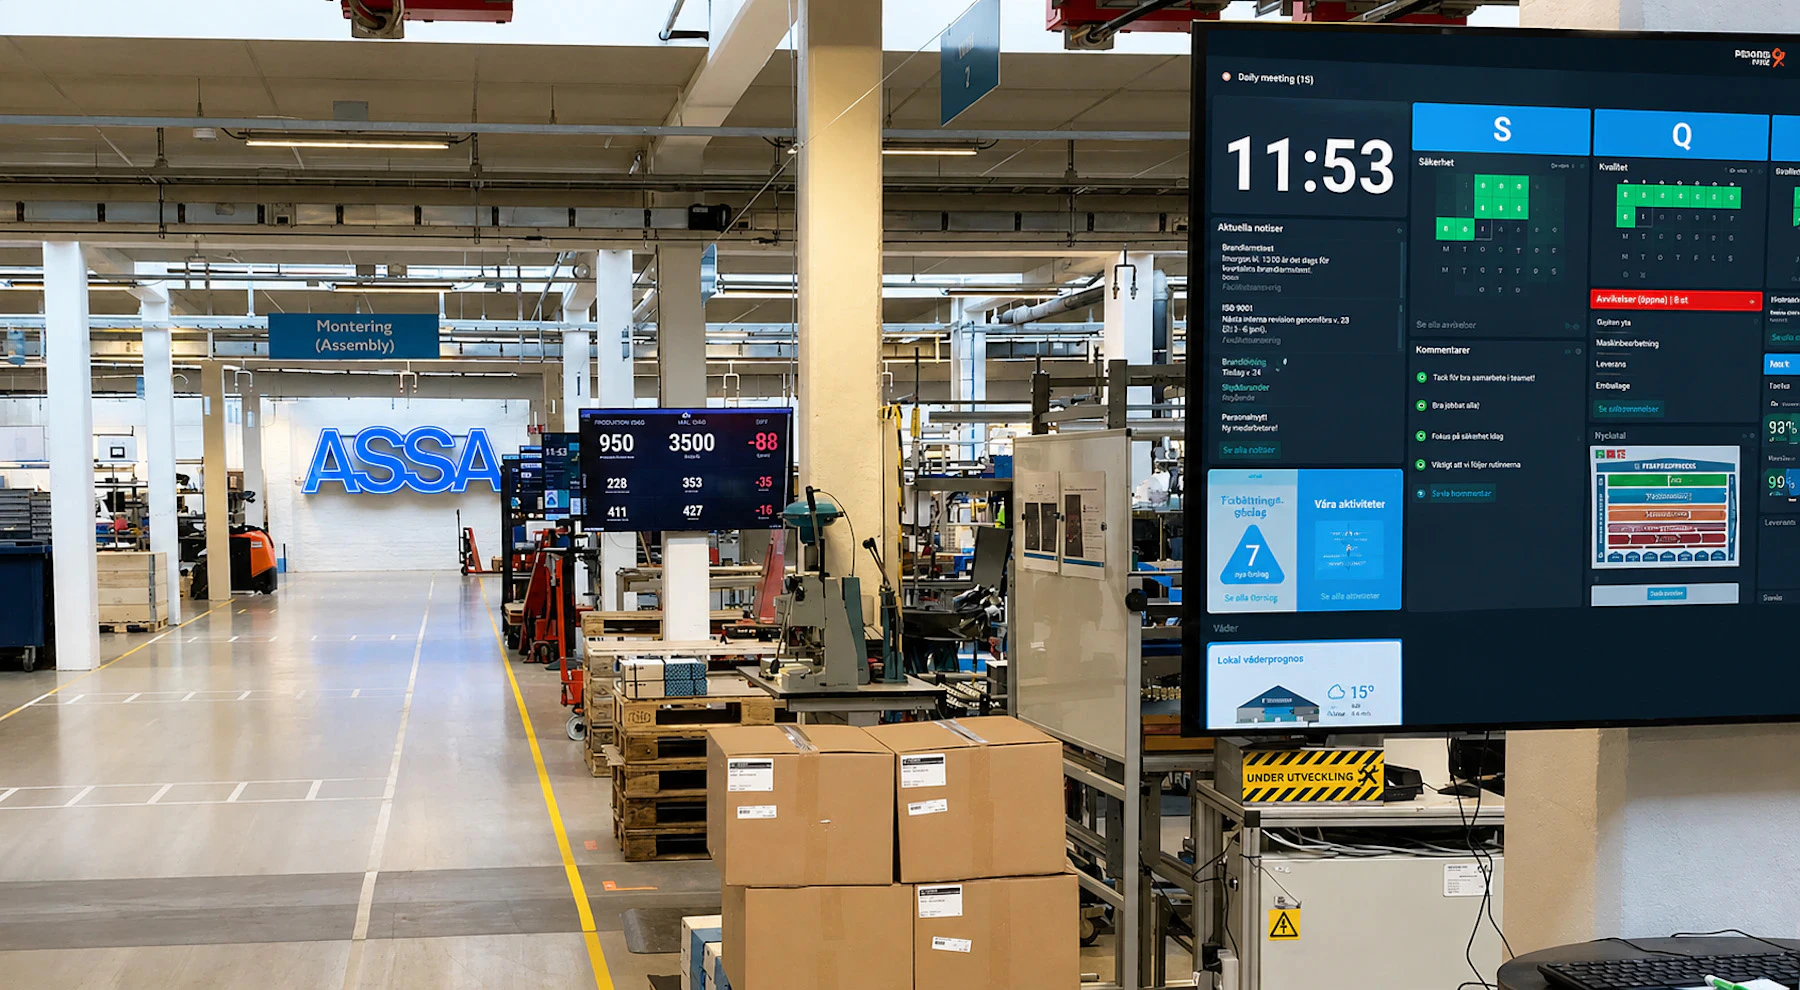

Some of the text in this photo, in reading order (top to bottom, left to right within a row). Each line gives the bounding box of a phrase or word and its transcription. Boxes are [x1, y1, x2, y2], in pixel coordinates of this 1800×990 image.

[1260, 74, 1295, 85] meeting
[1493, 115, 1512, 142] S
[1672, 122, 1692, 151] Q
[1226, 135, 1394, 195] 11:53
[316, 319, 393, 335] Montering
[315, 339, 395, 355] (Assembly)
[1415, 345, 1471, 355] Kommentarer
[599, 433, 634, 453] 950
[668, 433, 716, 452] 3500
[747, 432, 778, 451] -88
[301, 425, 503, 495] ASSA
[607, 477, 628, 489] 228
[682, 476, 703, 489] 353
[755, 476, 773, 488] -35
[682, 504, 704, 517] 427
[755, 504, 773, 516] -16
[1338, 499, 1386, 509] aktiviteter
[607, 506, 627, 518] 411
[1245, 544, 1261, 567] 7
[1217, 655, 1241, 666] Lokal
[1247, 771, 1354, 783] UNDER UTVECKLING
